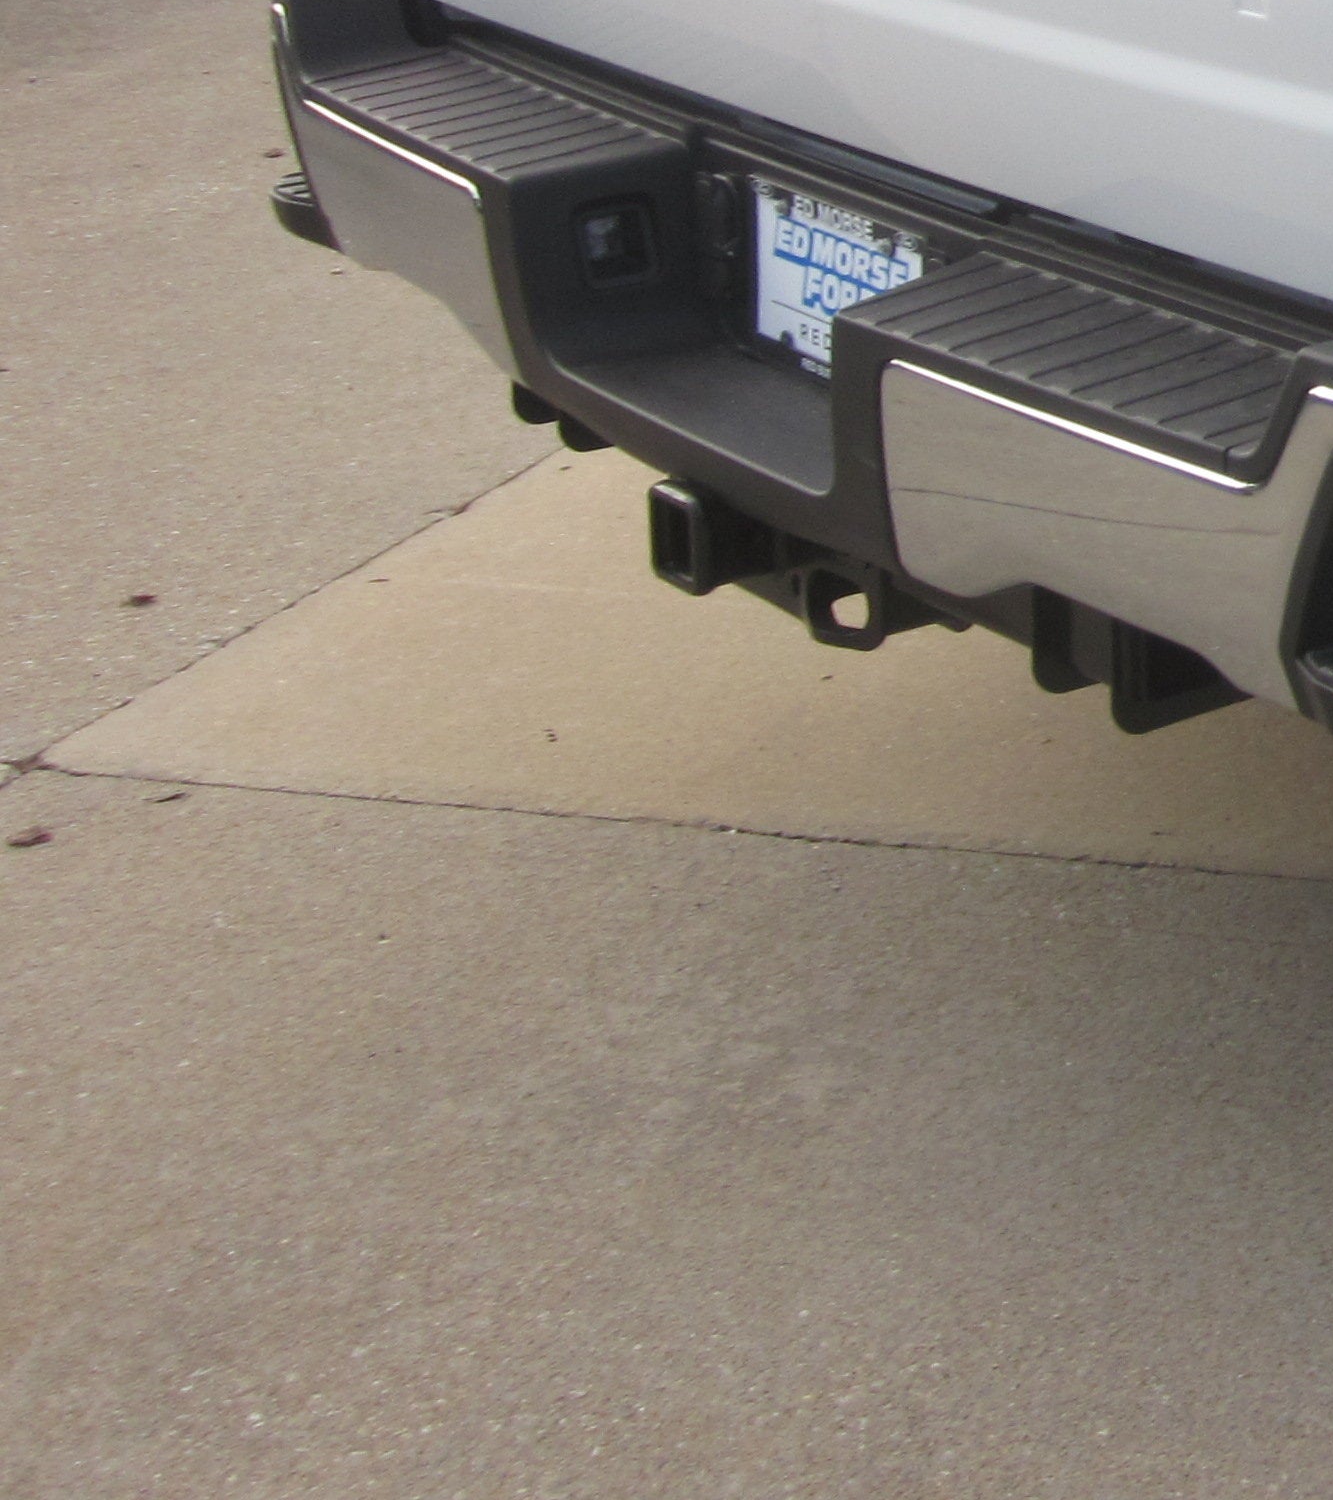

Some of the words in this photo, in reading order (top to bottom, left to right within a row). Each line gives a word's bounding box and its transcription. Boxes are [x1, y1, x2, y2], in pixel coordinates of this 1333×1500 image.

[792, 195, 815, 219] ED
[816, 201, 875, 242] MORSE
[775, 216, 810, 259] ED
[811, 228, 909, 290] MORSE
[805, 266, 876, 313] FOR
